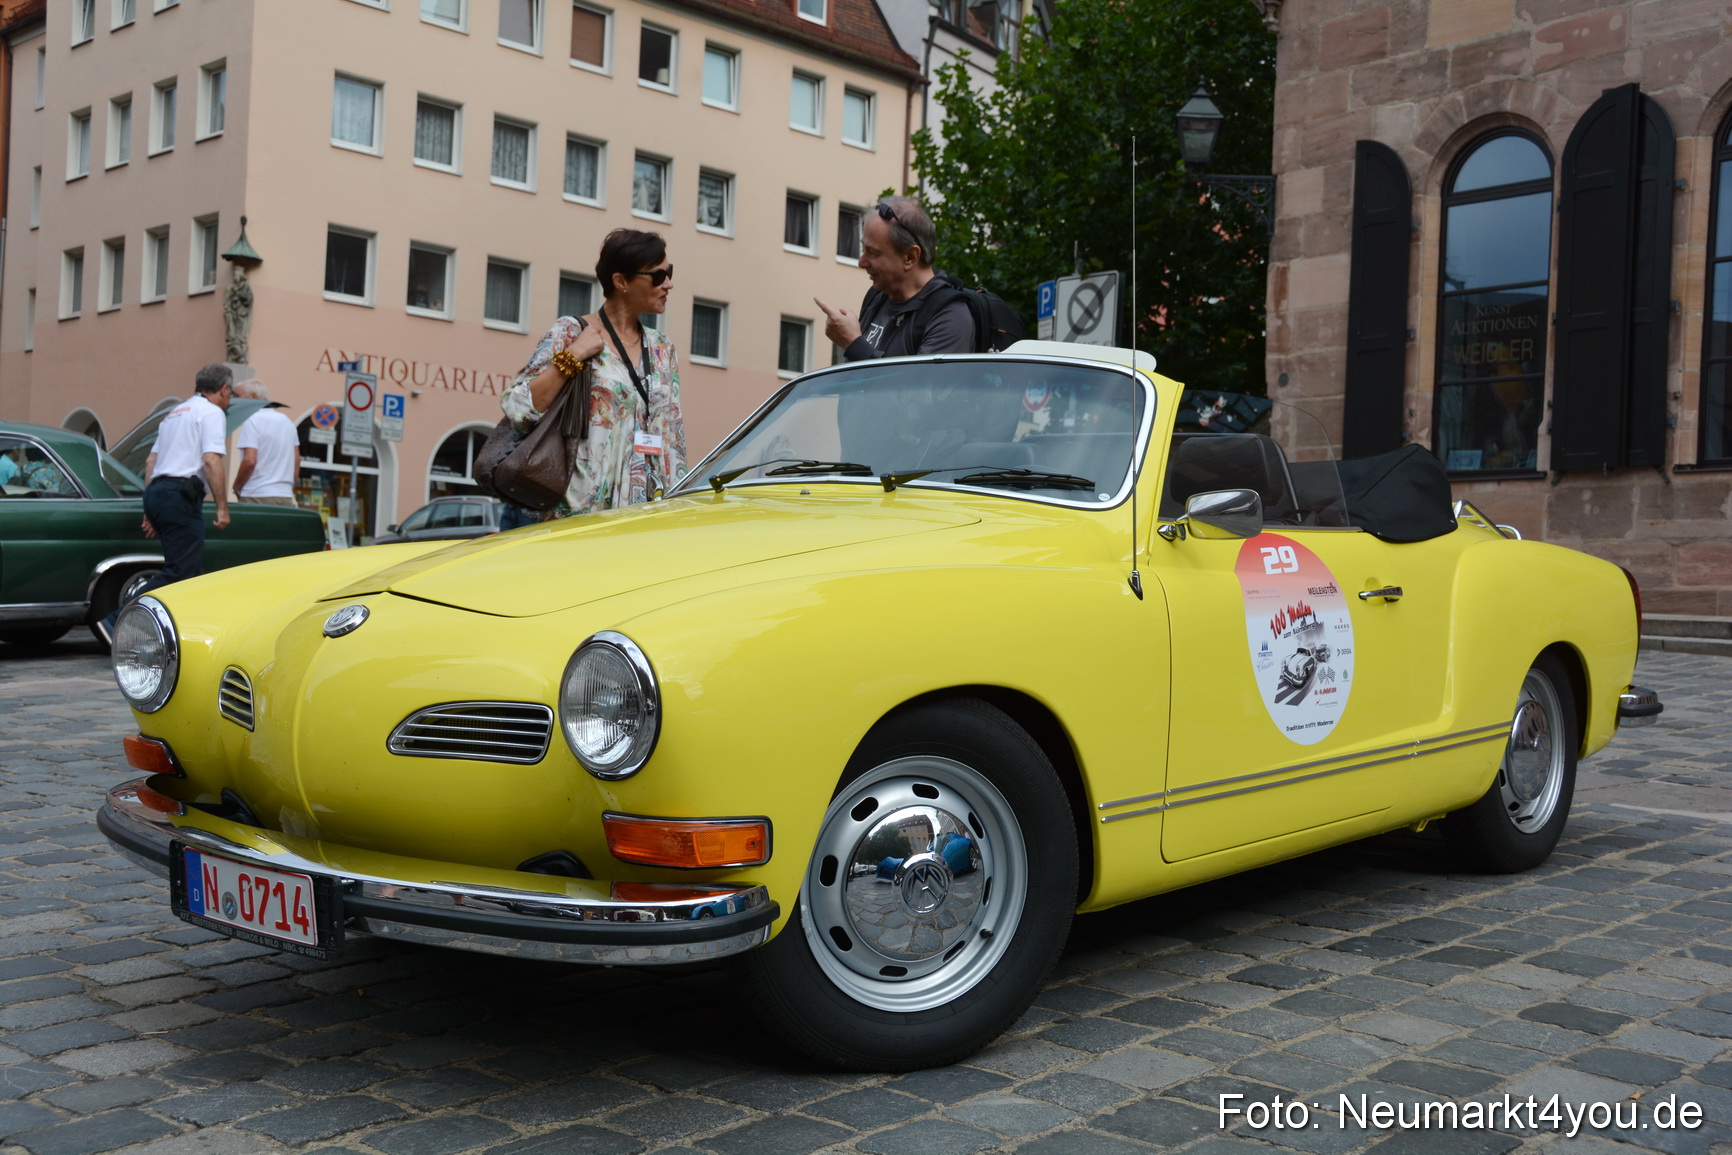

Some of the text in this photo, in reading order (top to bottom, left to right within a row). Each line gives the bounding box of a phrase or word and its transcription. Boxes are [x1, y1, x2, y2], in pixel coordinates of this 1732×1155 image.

[1476, 303, 1512, 318] KUNST
[1450, 314, 1539, 337] AUKTIONEN
[1453, 338, 1534, 366] WEIDLER
[1260, 545, 1299, 575] 29
[1270, 599, 1312, 640] 100 Meilen
[1283, 621, 1316, 639] um Nürnberg
[1286, 724, 1305, 732] Tradition
[1316, 719, 1334, 728] Moderne
[193, 888, 200, 902] D
[203, 862, 310, 936] N 0714
